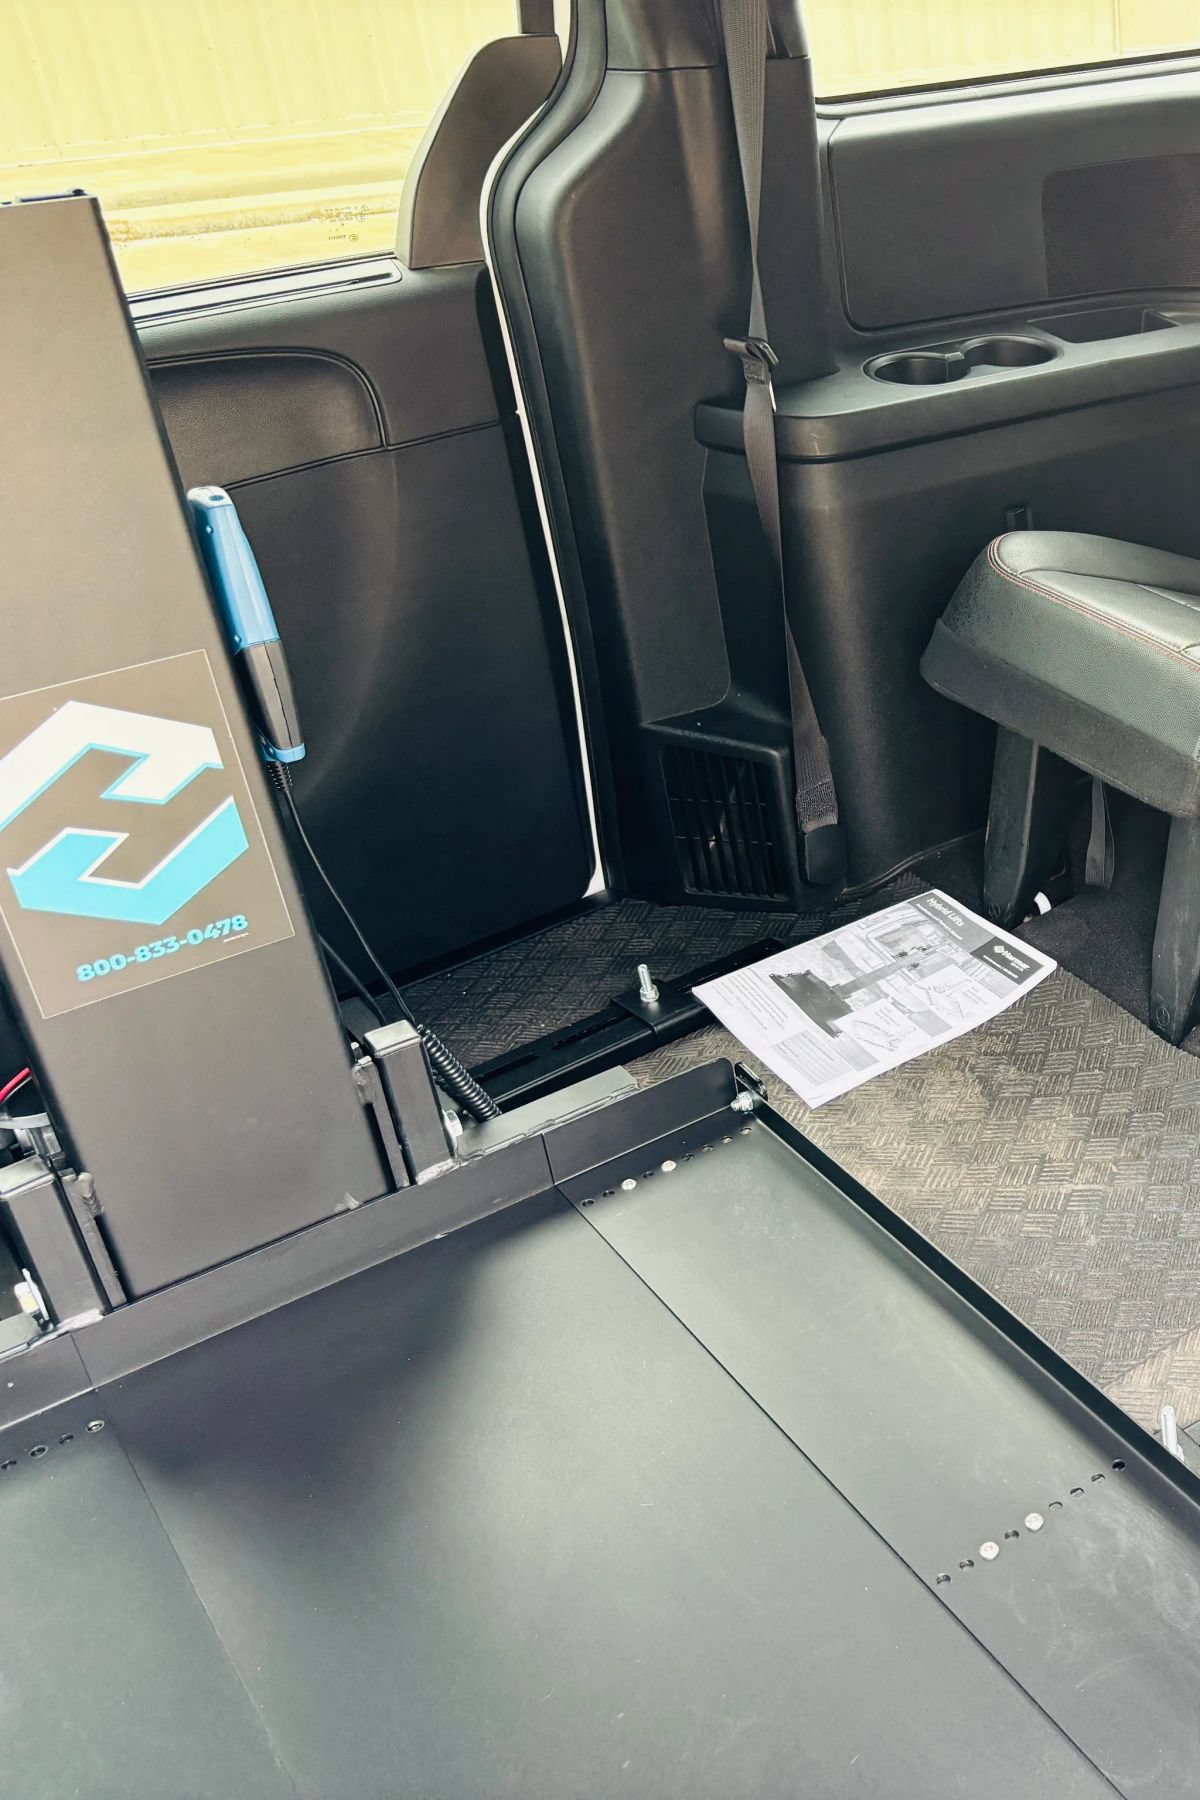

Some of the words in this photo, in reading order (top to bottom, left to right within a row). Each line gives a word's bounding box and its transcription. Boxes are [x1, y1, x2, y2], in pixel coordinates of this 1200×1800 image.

[926, 897, 953, 915] Hybrid
[948, 912, 966, 927] Lifts
[76, 914, 248, 981] 800-833-0478
